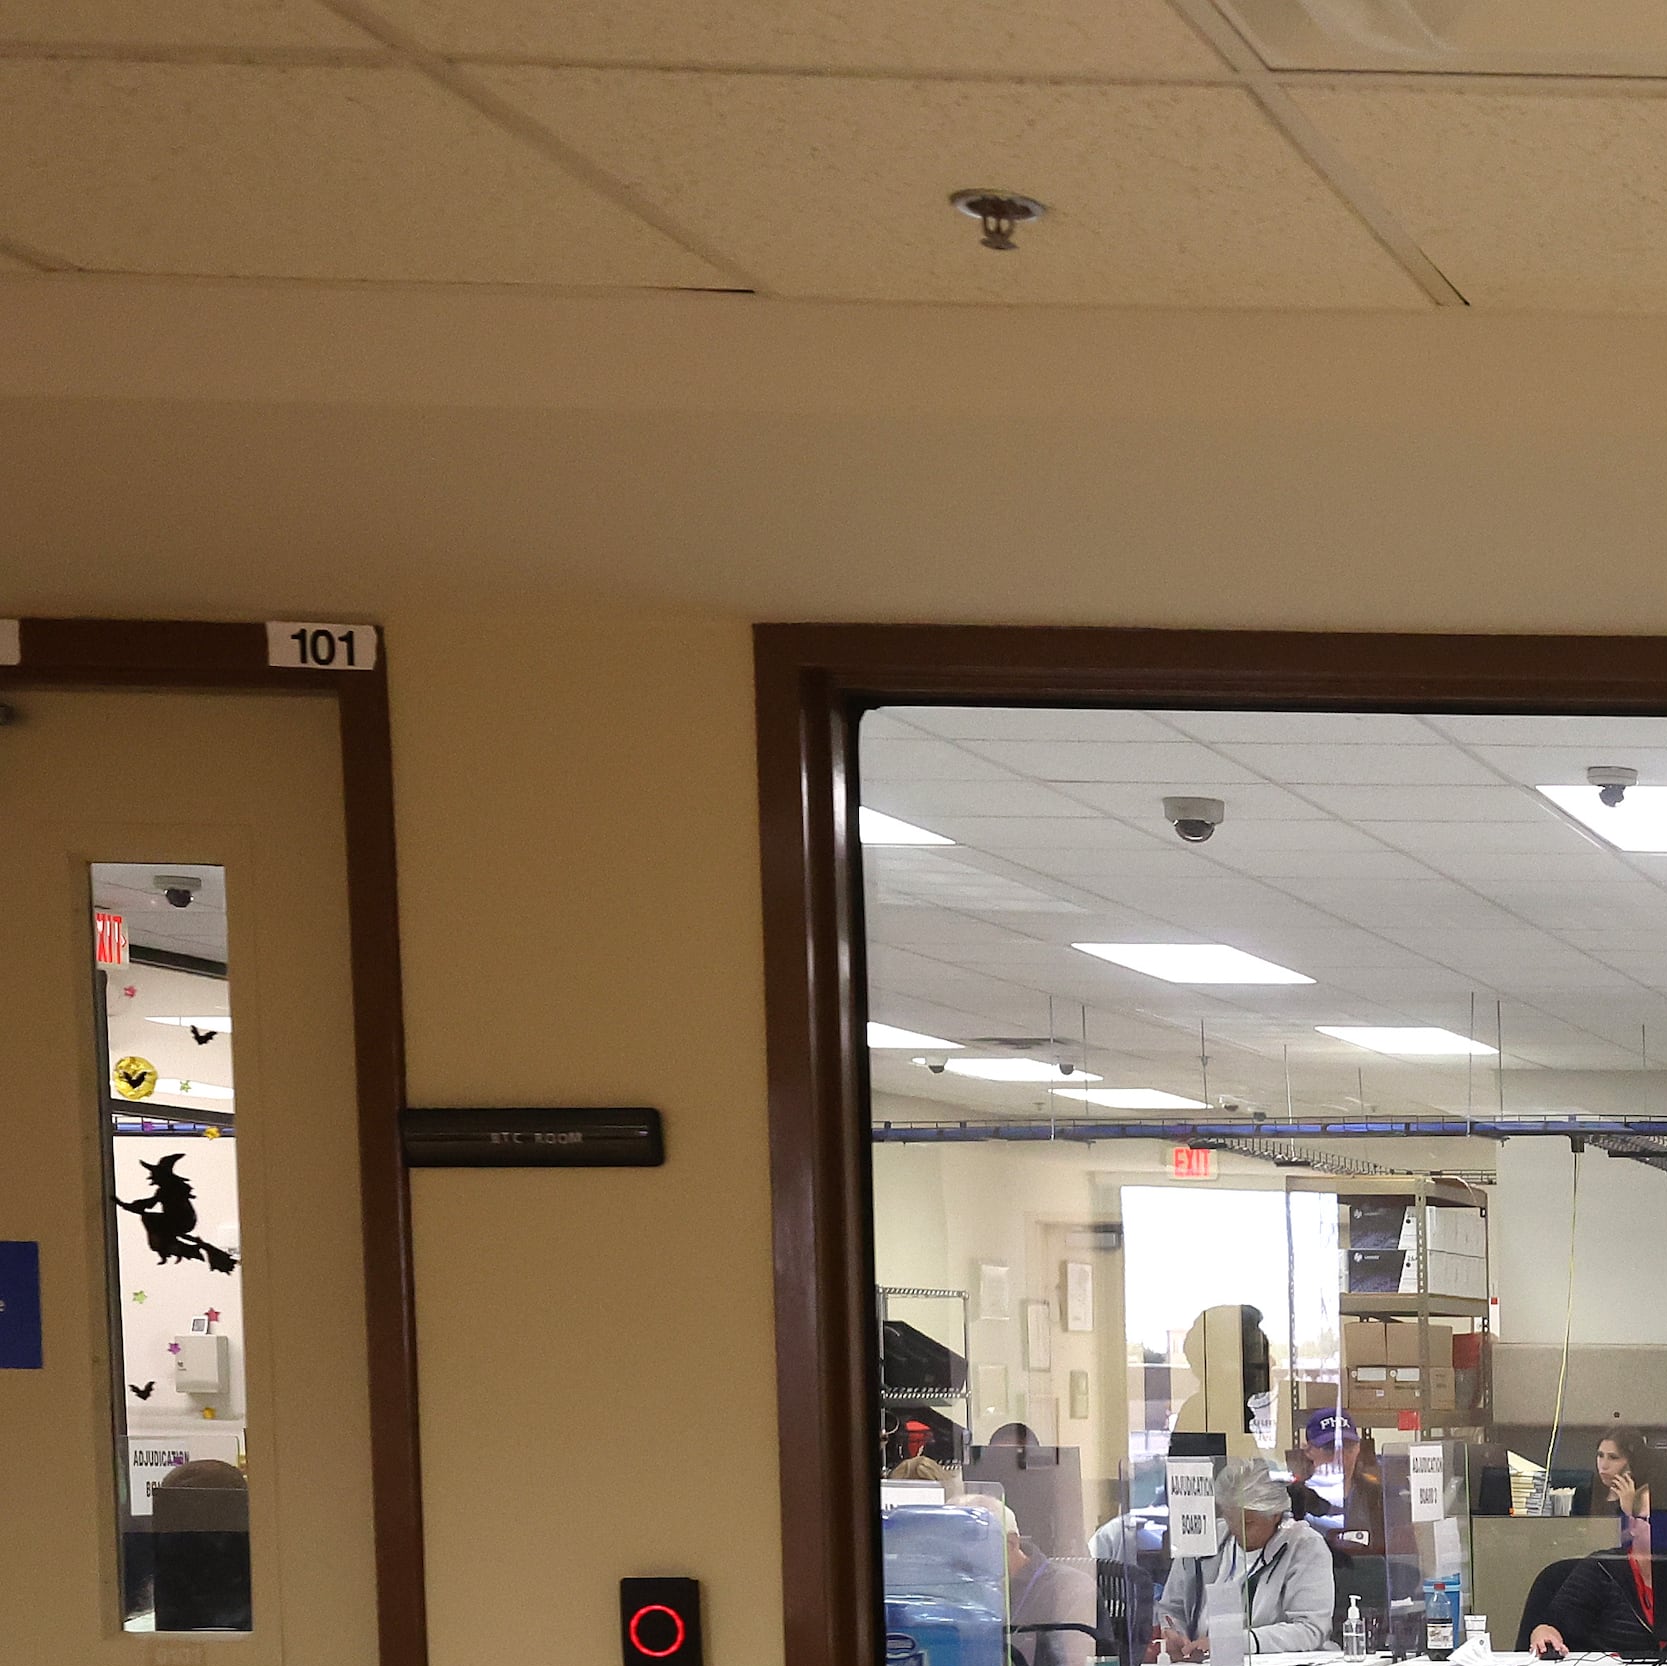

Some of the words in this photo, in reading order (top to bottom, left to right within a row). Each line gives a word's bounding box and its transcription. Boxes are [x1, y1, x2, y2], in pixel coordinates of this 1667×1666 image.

[290, 628, 355, 666] 101
[97, 913, 122, 964] XIT
[534, 1131, 583, 1144] ROOM
[1175, 1148, 1209, 1176] EXIT
[1182, 1514, 1201, 1534] BOARD
